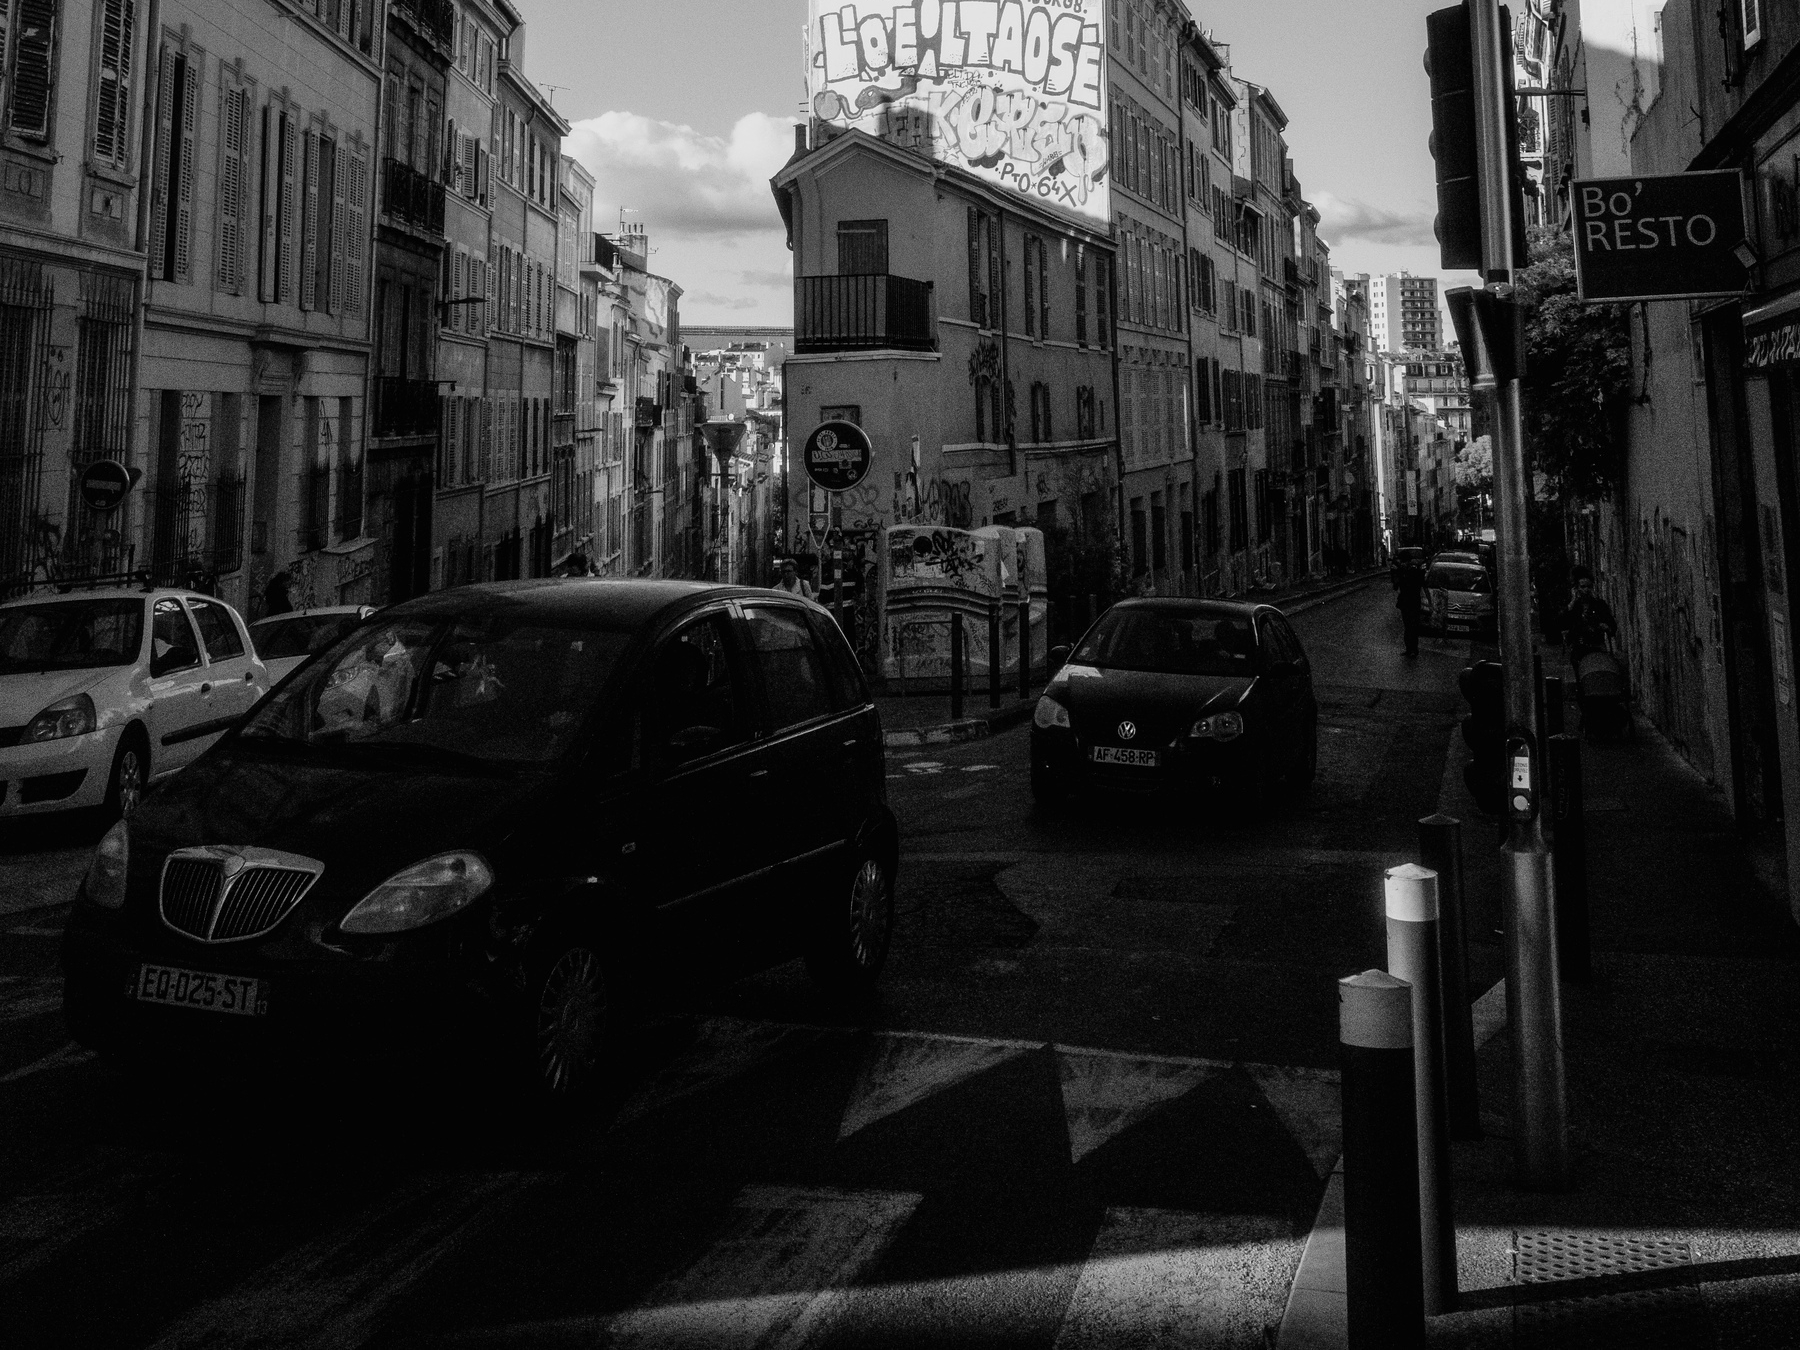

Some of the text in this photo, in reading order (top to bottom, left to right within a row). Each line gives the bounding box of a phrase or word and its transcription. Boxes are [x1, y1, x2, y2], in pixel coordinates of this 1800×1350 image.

[1582, 181, 1643, 217] Bo'
[1585, 214, 1716, 251] RESTO
[1096, 748, 1154, 764] AF-458-RP
